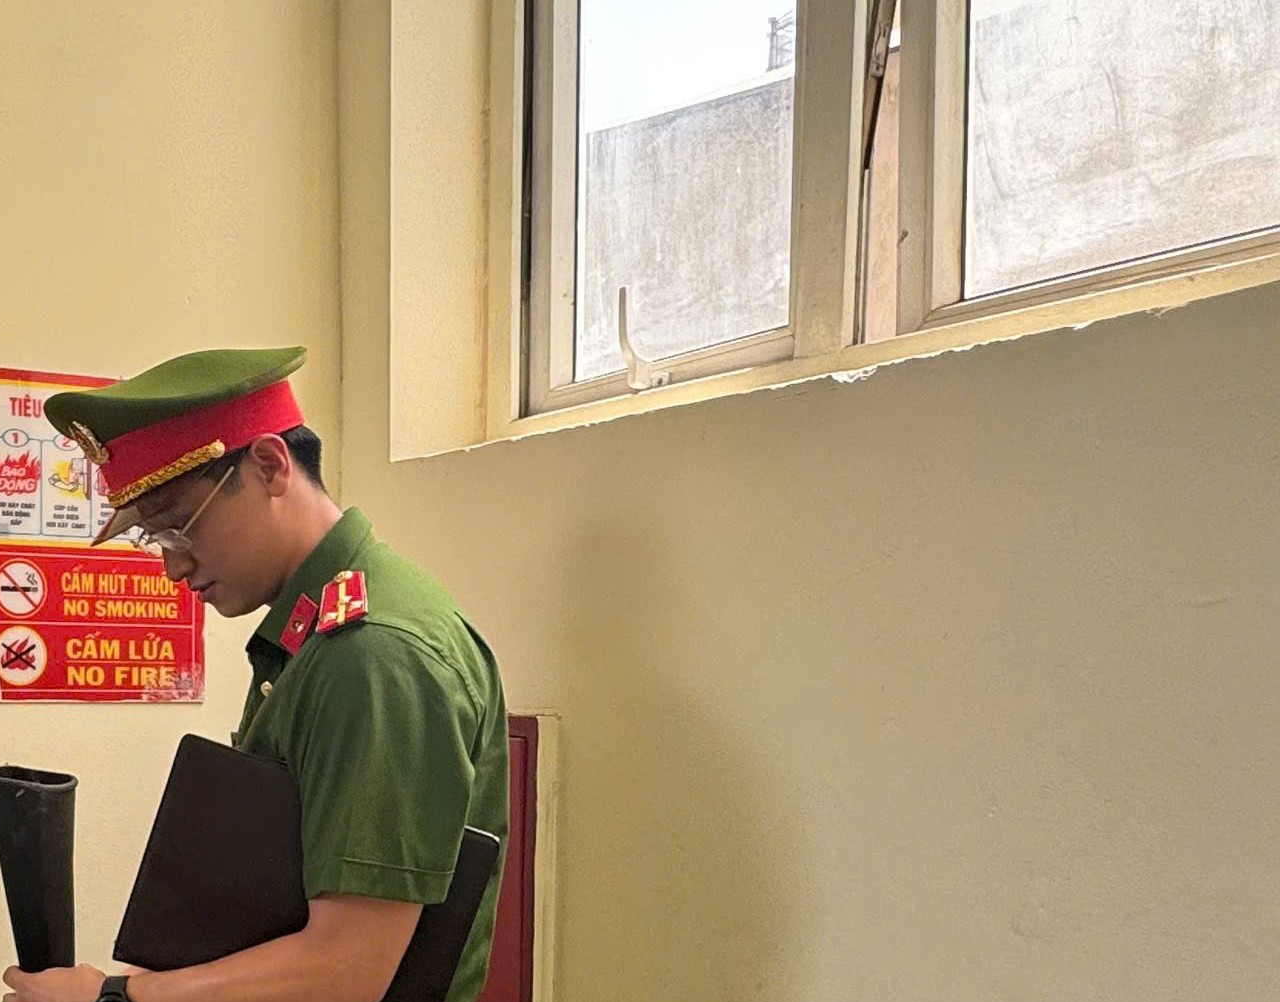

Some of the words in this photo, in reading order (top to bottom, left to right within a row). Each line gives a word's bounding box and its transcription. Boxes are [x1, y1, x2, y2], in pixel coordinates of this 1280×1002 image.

[9, 394, 42, 418] TIÊU
[12, 432, 19, 444] 1
[61, 565, 94, 594] CẤM
[98, 568, 127, 595] HÚT
[63, 599, 89, 617] NO
[95, 600, 178, 619] SMOKING
[66, 631, 120, 660] CẤM
[128, 632, 175, 660] LỬA
[67, 666, 105, 686] NO
[114, 666, 175, 687] FIRE
